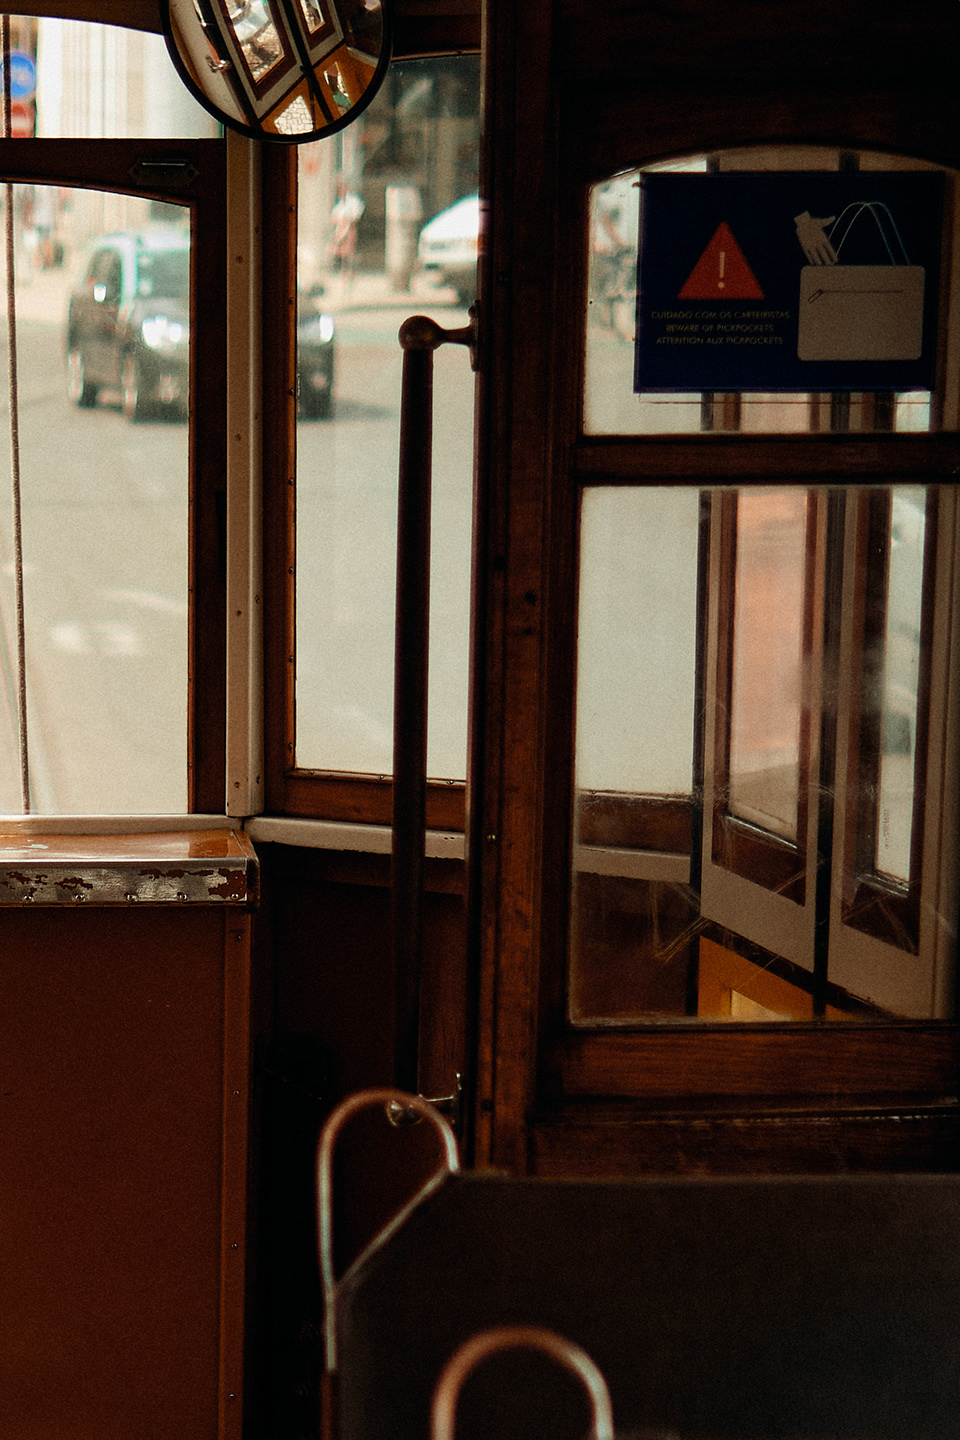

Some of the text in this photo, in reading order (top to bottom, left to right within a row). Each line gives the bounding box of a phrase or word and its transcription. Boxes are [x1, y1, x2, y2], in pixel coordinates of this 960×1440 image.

[650, 310, 790, 319] CUIDADO COM OS CARTEIRISTAS
[666, 323, 774, 332] BEWARE OF PICKPOCKETS
[655, 336, 783, 345] ATTENTION AUX PICKPOCKETS
